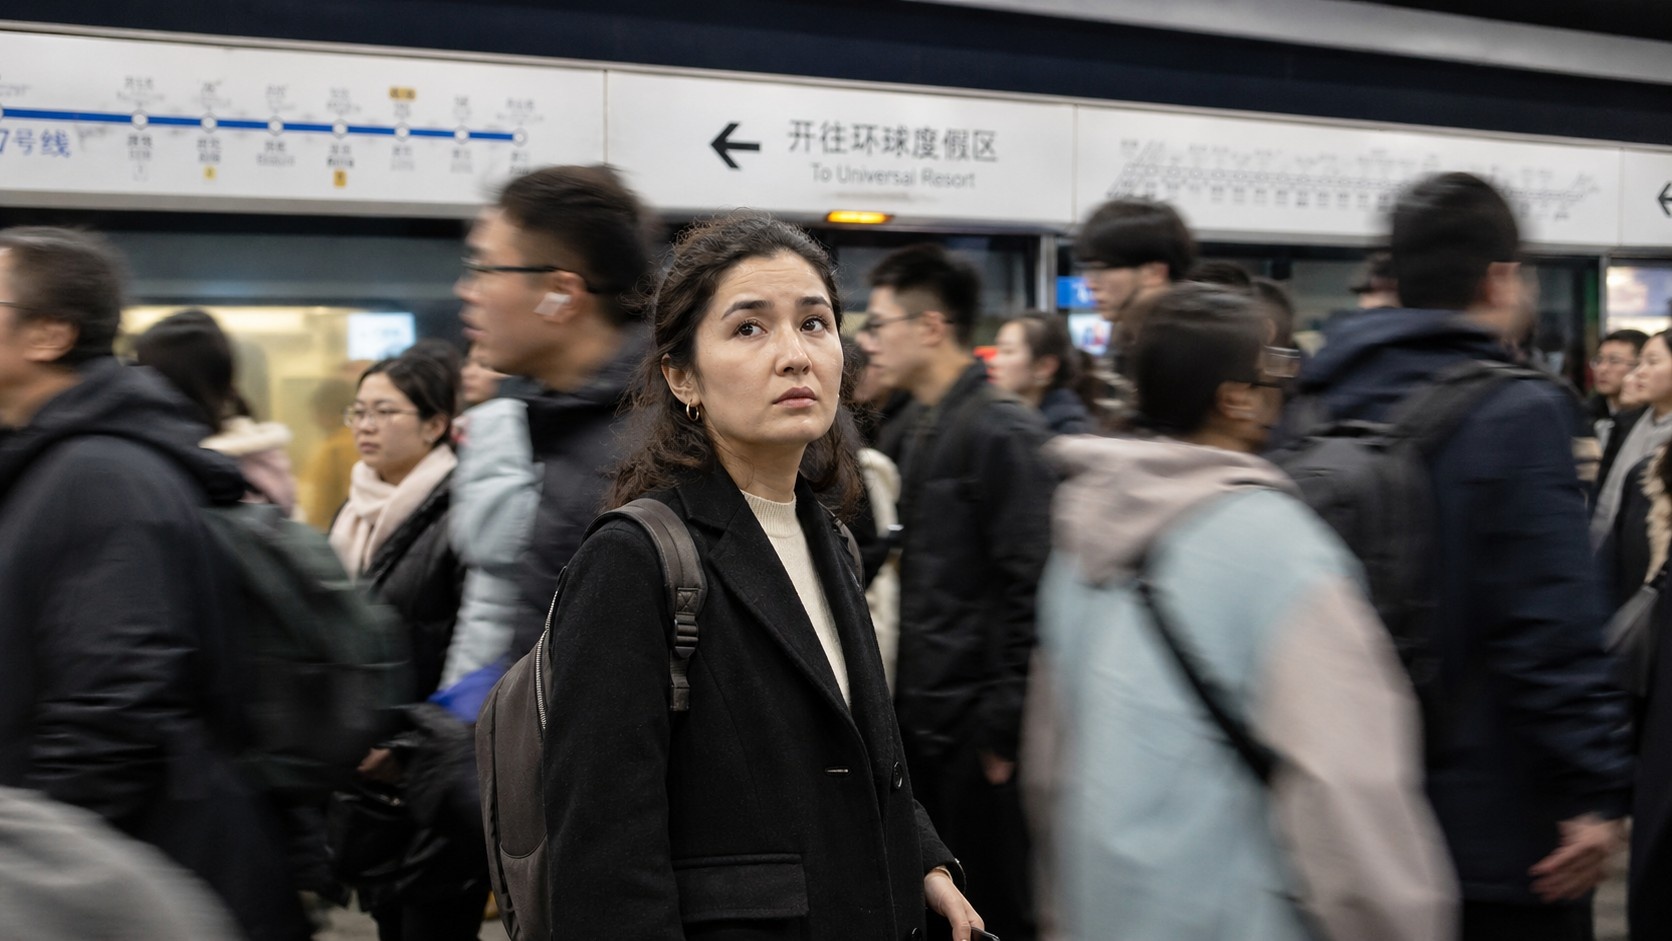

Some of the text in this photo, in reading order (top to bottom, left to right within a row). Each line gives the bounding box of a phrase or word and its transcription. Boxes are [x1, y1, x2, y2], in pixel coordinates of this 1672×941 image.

[787, 119, 998, 163] 开往环球度假区
[810, 162, 976, 189] To Universal Resort
